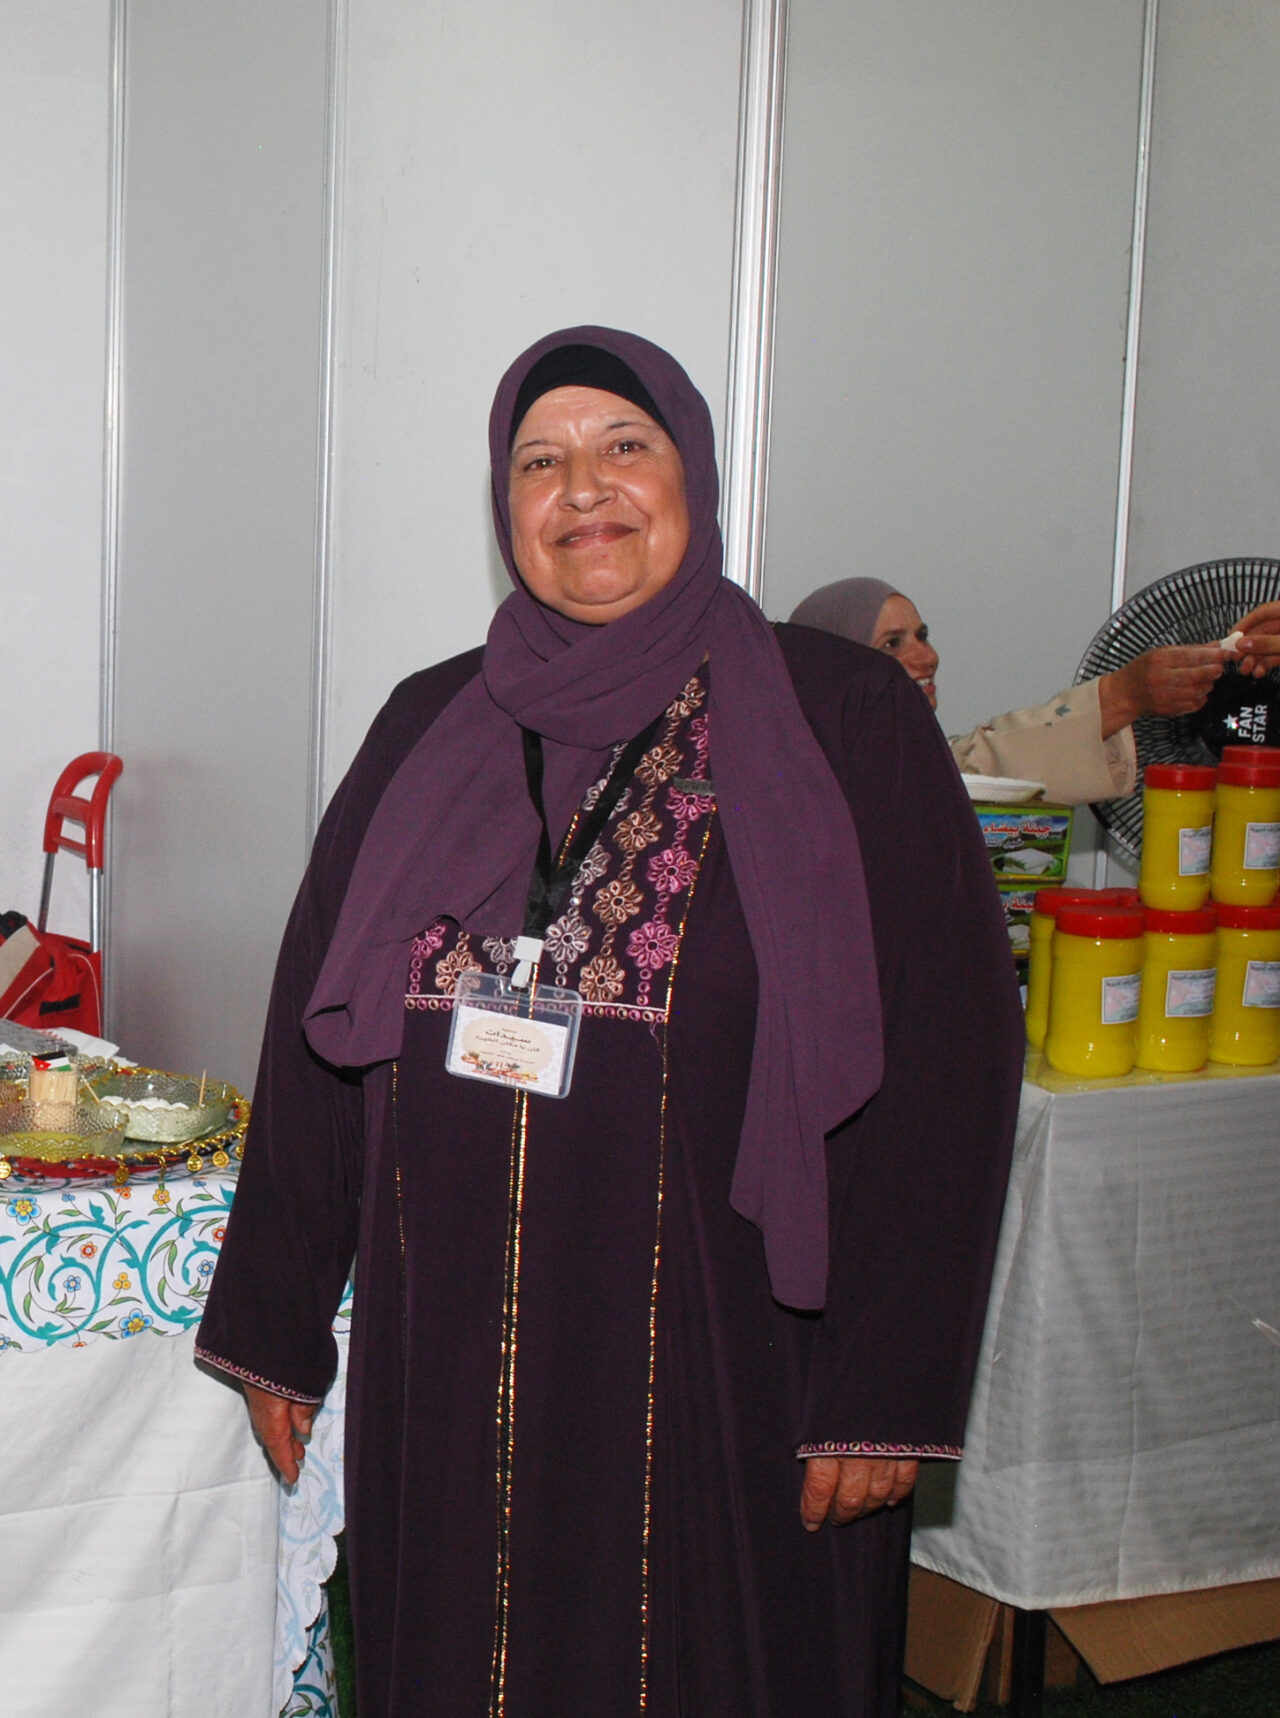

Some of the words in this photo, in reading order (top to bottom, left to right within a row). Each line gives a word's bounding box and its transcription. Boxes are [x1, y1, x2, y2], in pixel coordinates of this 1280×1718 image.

[1238, 706, 1253, 738] FAN
[1252, 704, 1267, 743] STAR
[983, 822, 1020, 837] بيضاء
[1023, 822, 1052, 837] جبنة
[1012, 898, 1035, 912] بنة
